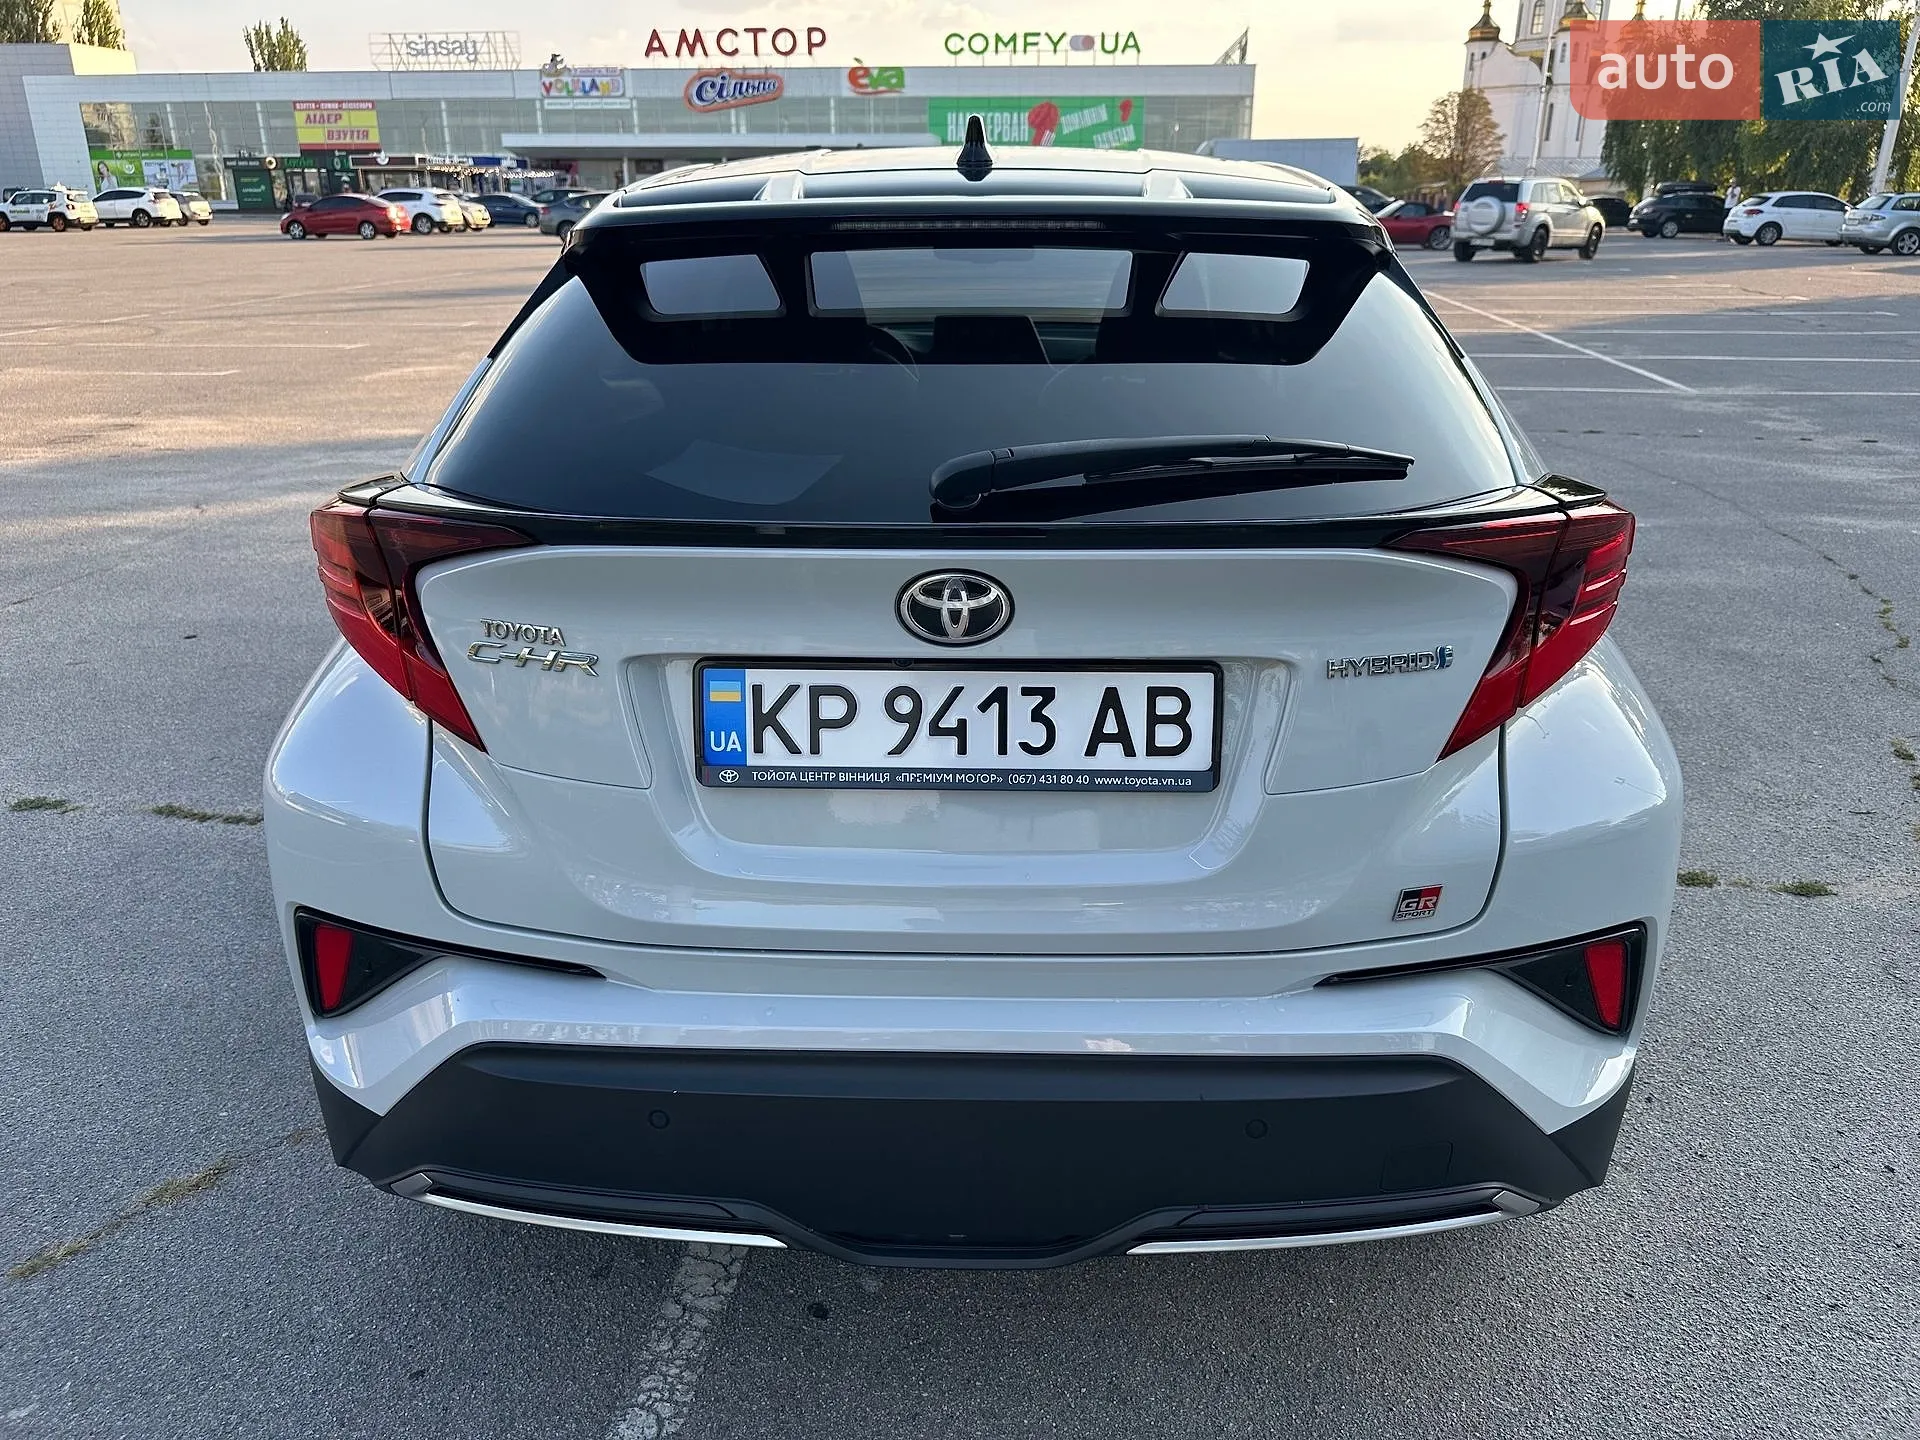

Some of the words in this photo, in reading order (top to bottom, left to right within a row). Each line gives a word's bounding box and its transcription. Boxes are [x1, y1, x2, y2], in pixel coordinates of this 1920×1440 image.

[644, 27, 827, 58] АМСТОР
[944, 32, 1067, 55] COMFY
[1100, 31, 1142, 55] UA
[304, 113, 343, 125] ЛІДЕР
[327, 129, 370, 141] ВЗУТТЯ
[480, 618, 567, 647] TOYOTA
[467, 640, 599, 677] C-HR
[1326, 651, 1436, 679] HYBRID
[751, 684, 858, 756] KP
[883, 685, 1057, 756] 9413
[1083, 686, 1193, 758] AB
[710, 730, 743, 752] UA
[752, 769, 797, 782] ТОЙОТА
[800, 771, 836, 785] ЦЕНТР
[839, 772, 890, 785] ВІННИЦЯ
[895, 772, 953, 784] «ПРЕМІУМ
[955, 773, 1004, 784] МОТОР»
[1008, 774, 1037, 786] (067)
[1039, 774, 1057, 785] 431
[1059, 775, 1074, 785] 80
[1075, 775, 1090, 785] 40
[1094, 775, 1192, 788] www.toyota.vn.ua
[1396, 909, 1435, 919] SPORT
[1399, 896, 1438, 912] GR
